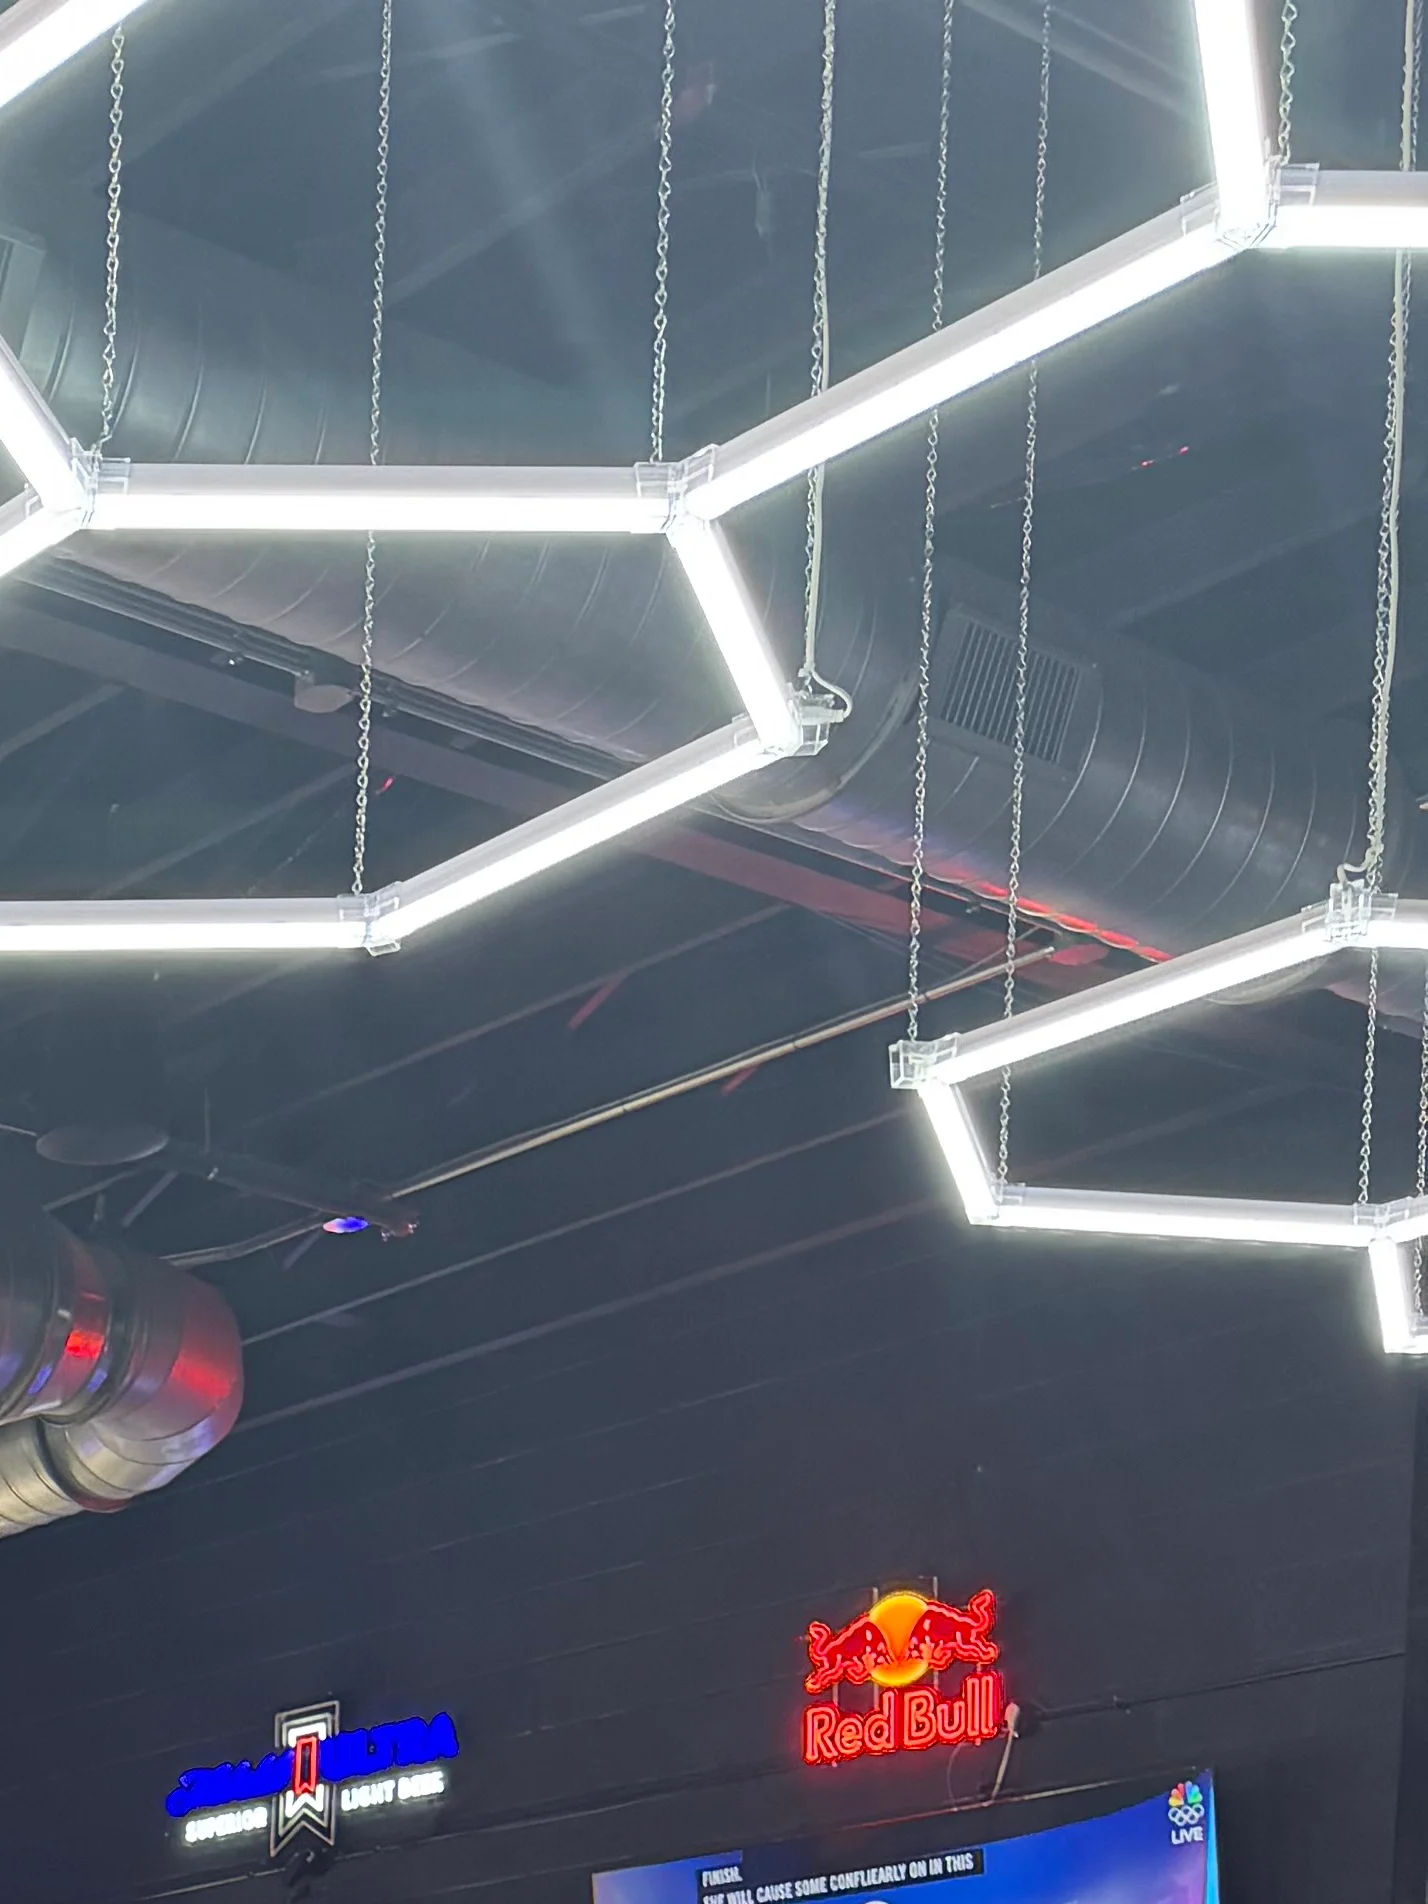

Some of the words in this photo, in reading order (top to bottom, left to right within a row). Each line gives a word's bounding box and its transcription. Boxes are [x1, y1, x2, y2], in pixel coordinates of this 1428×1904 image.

[804, 1689, 898, 1765] Red
[902, 1672, 999, 1750] Bull
[1171, 1826, 1204, 1845] LIVE
[756, 1884, 792, 1903] CAUSE
[795, 1879, 828, 1896] SOME
[910, 1862, 927, 1878] ON
[929, 1859, 943, 1875] IN
[945, 1853, 974, 1873] THIS
